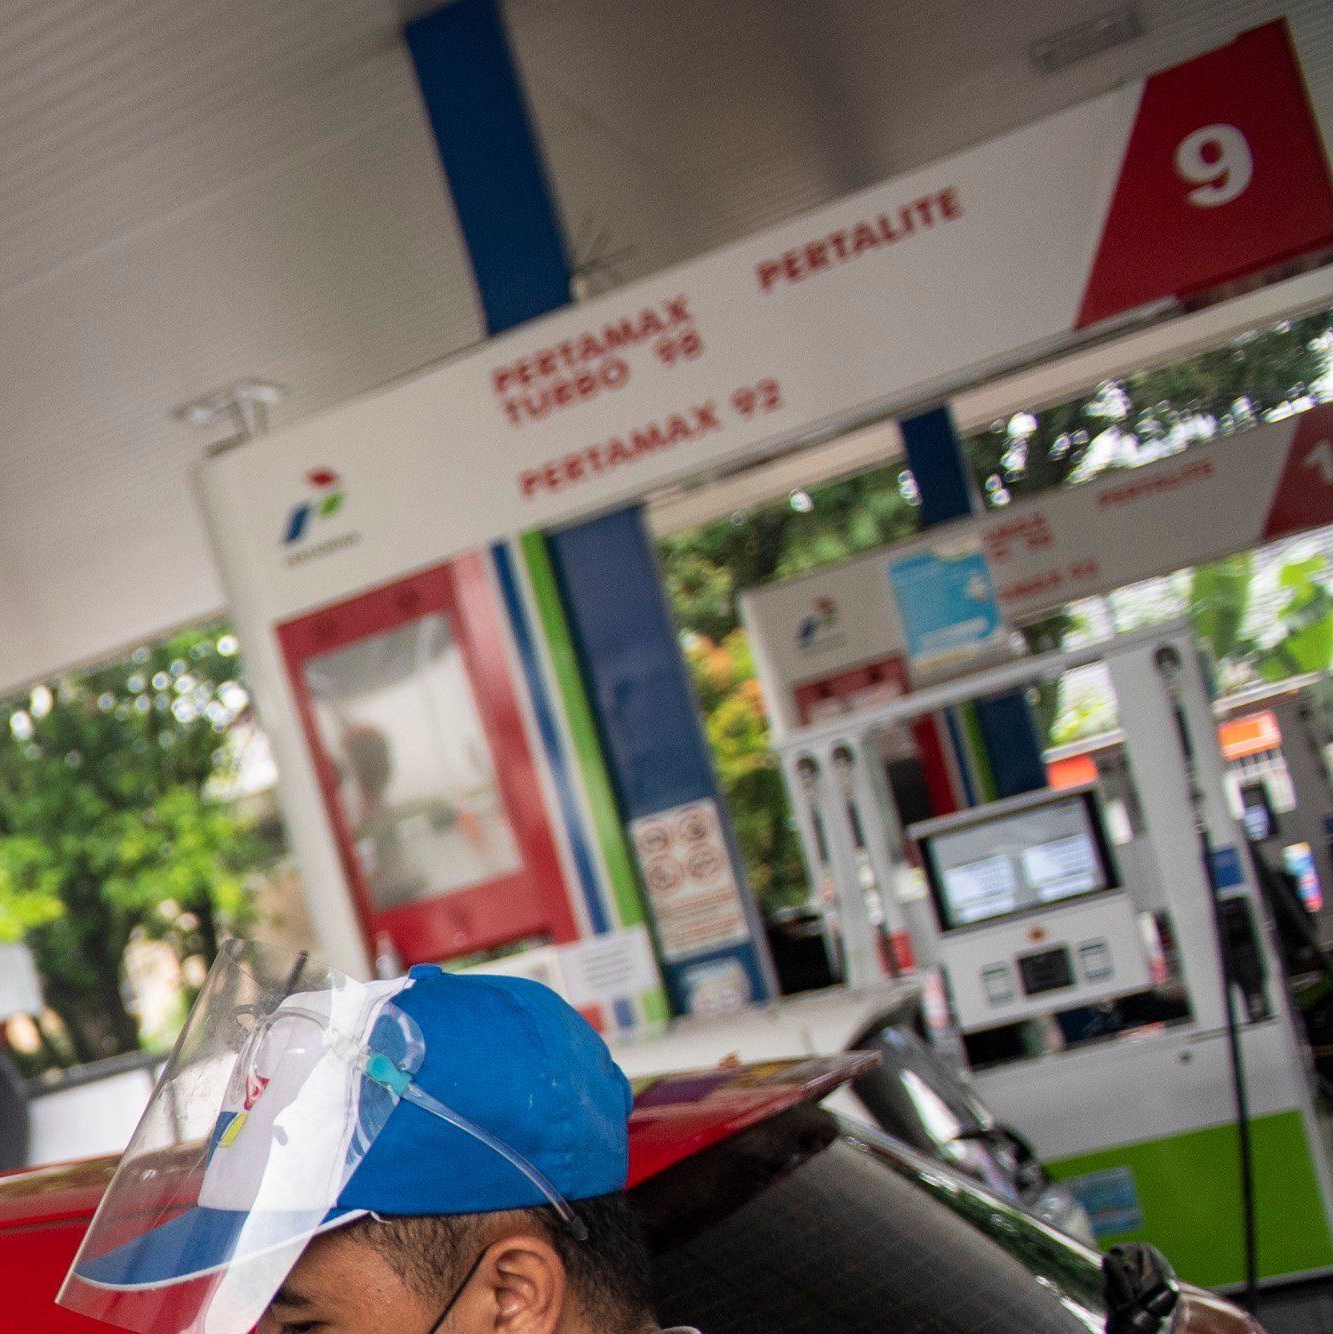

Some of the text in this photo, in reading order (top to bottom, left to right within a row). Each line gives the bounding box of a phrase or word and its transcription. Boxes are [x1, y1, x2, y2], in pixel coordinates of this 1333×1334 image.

[1171, 122, 1255, 209] 9
[754, 186, 964, 293] PERTALITE
[491, 294, 694, 395] PERTAMAX
[501, 329, 705, 428] TURBO 98
[518, 399, 723, 500] PERTAMAX
